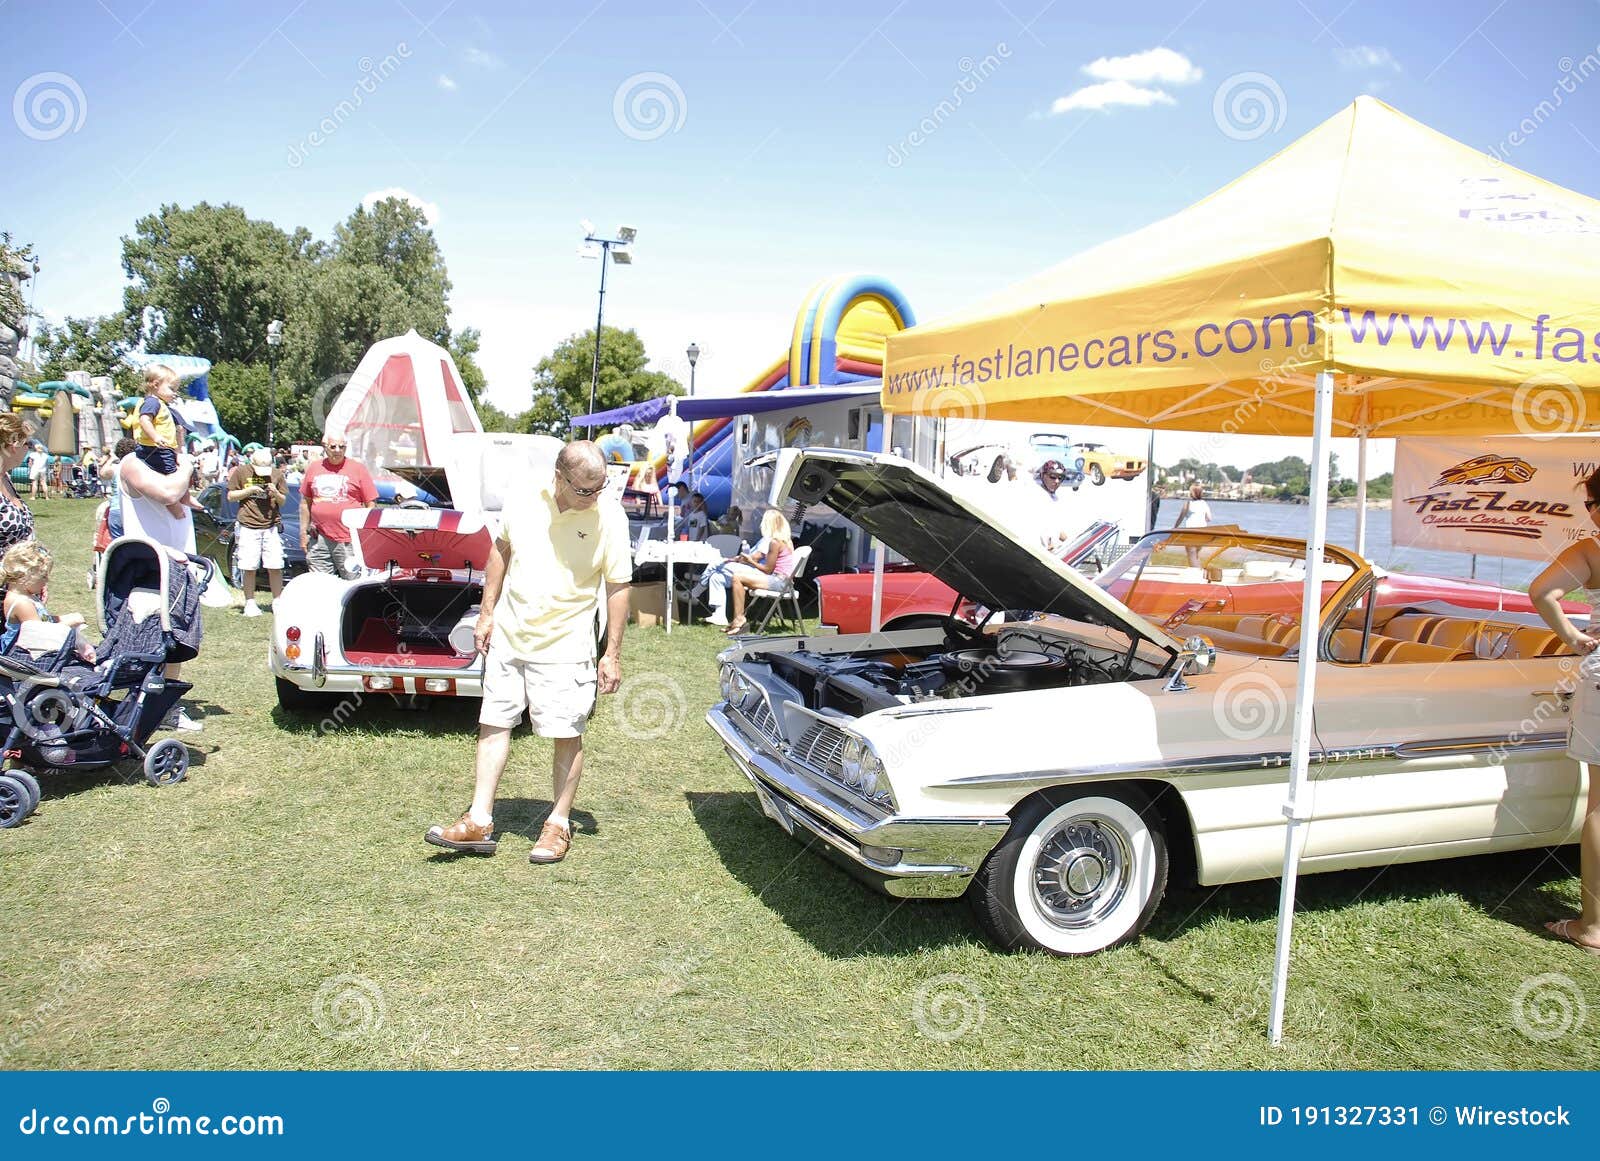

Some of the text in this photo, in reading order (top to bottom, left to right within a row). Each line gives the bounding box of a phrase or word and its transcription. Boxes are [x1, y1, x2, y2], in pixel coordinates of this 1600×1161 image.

[888, 309, 1317, 396] www.fastlanecars.com
[1341, 307, 1600, 364] www.fa
[1402, 490, 1574, 518] Fast Lane
[1422, 514, 1469, 525] Classic
[1470, 513, 1512, 525] Cars
